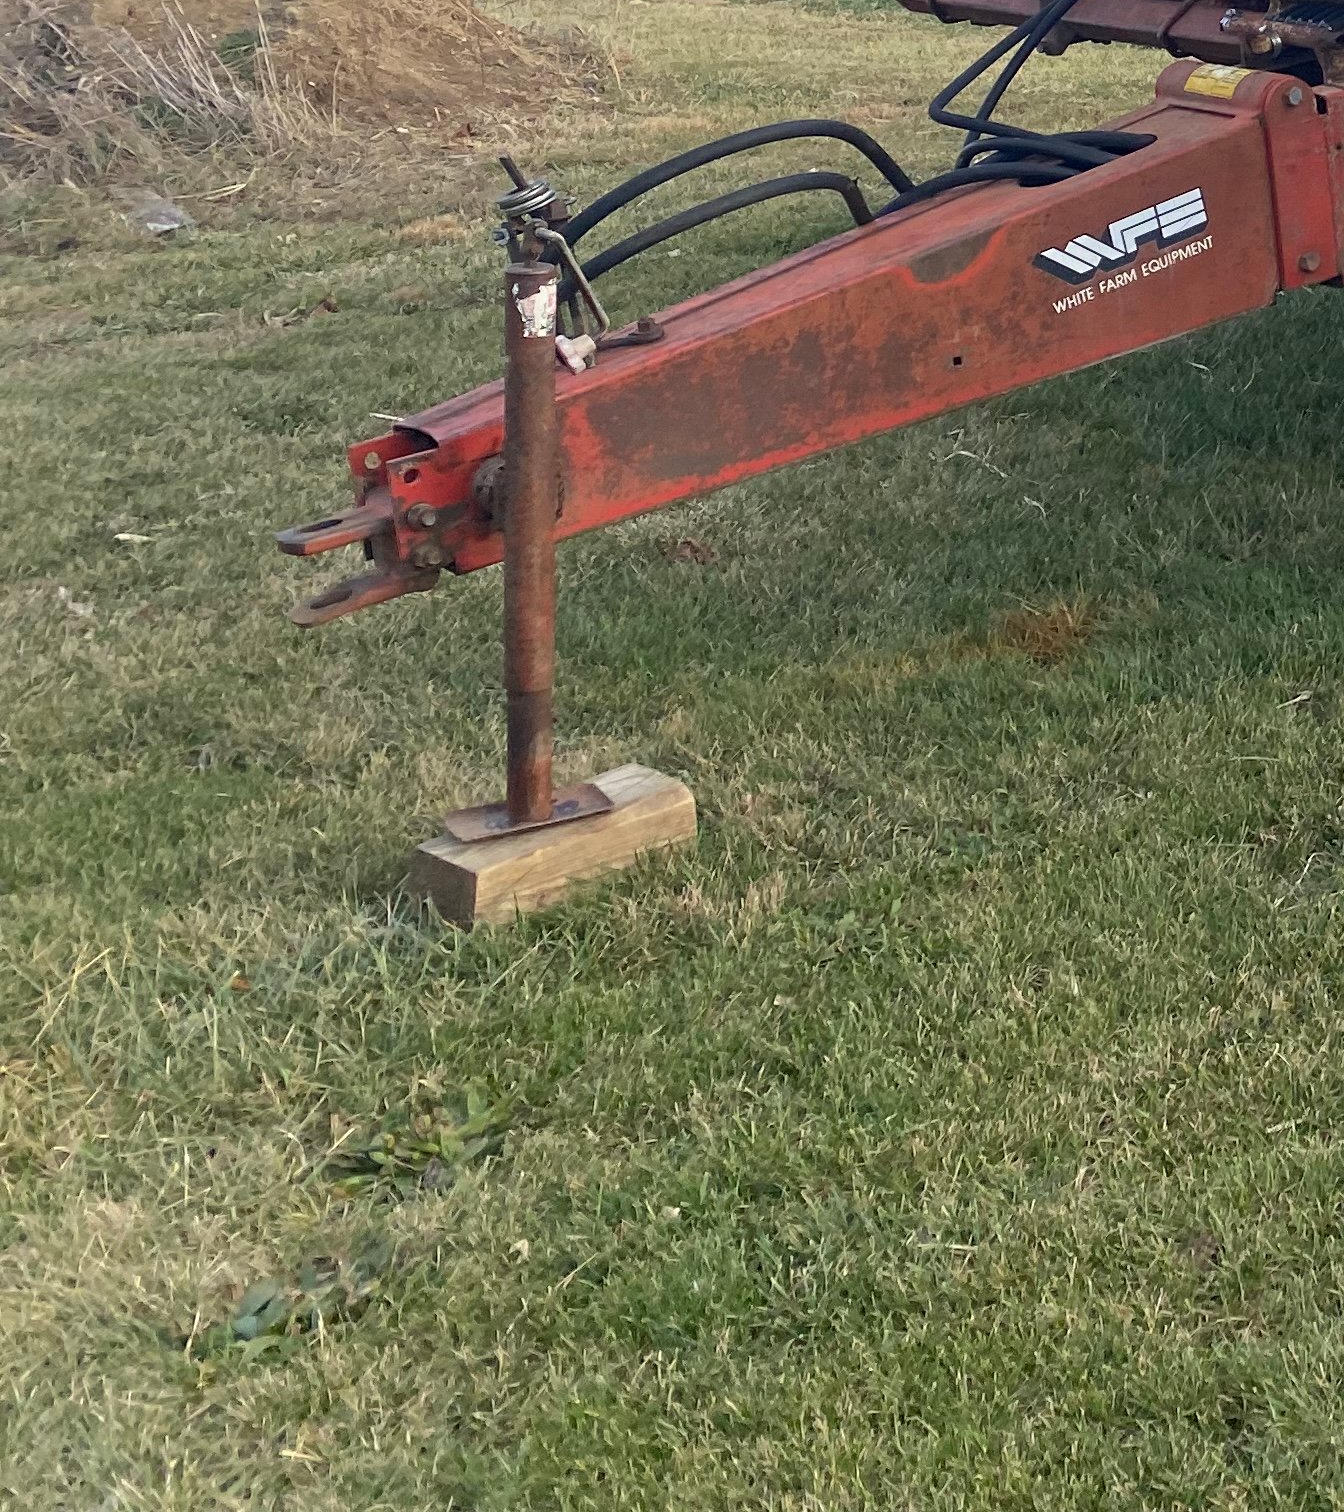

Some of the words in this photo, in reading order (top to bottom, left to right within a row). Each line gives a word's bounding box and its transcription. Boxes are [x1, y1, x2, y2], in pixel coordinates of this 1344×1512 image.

[1052, 287, 1095, 315] WHITE
[1099, 268, 1138, 295] FARM
[1142, 235, 1213, 278] EQUIPMENT
